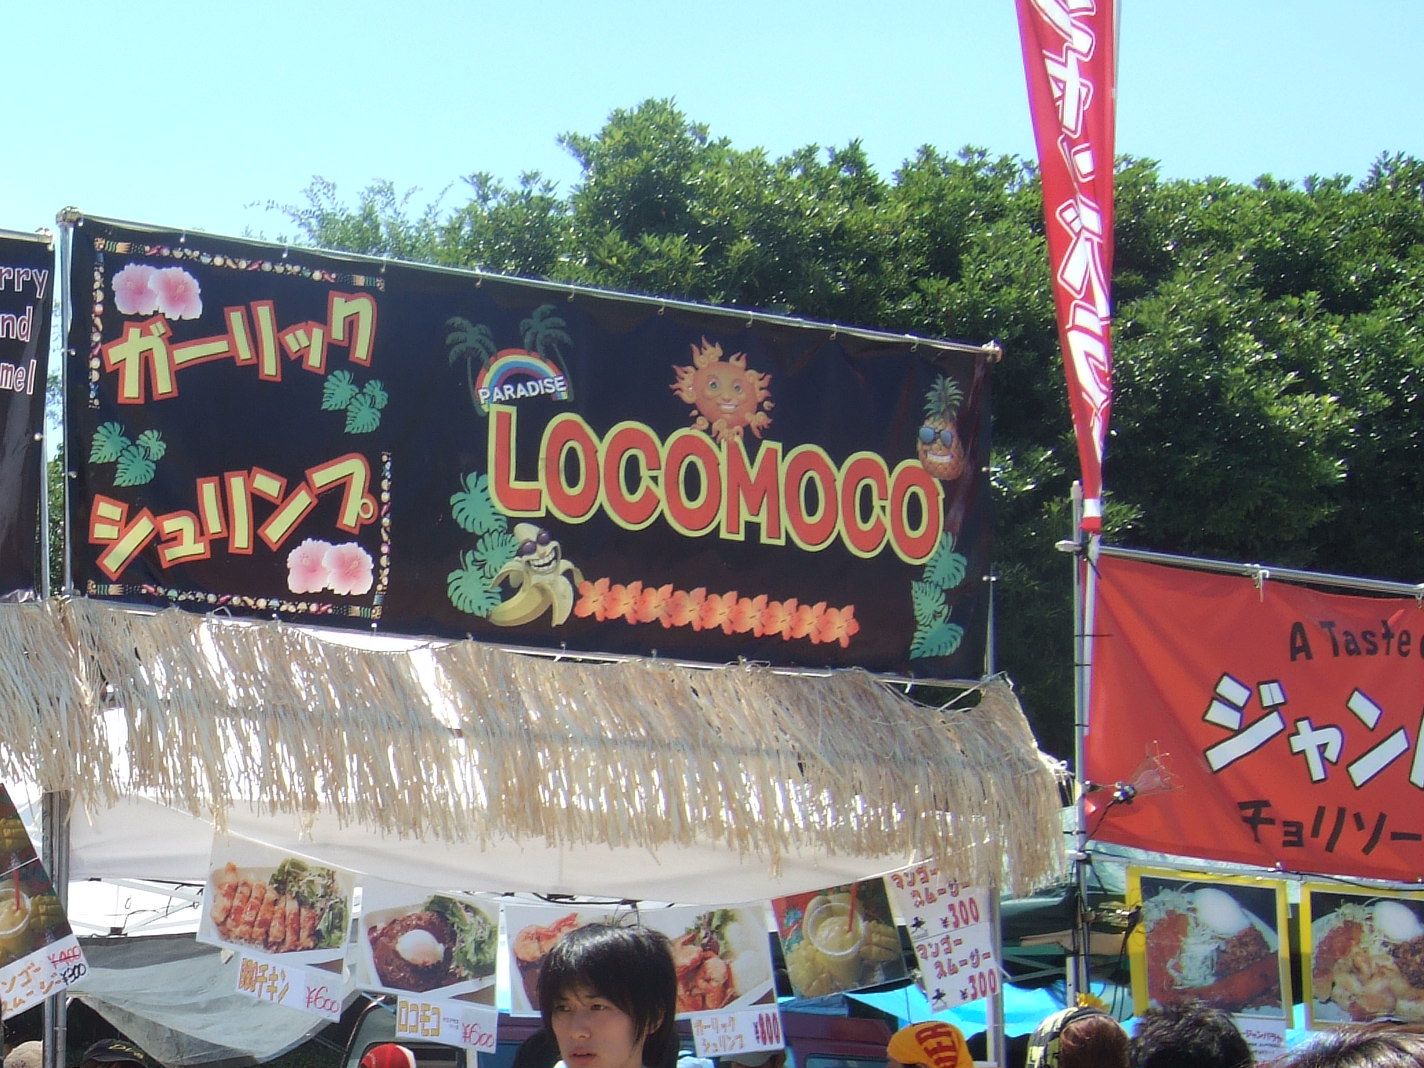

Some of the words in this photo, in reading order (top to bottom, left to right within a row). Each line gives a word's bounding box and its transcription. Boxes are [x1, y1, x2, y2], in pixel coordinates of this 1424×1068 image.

[102, 290, 378, 404] ガーリック
[478, 375, 568, 404] PARADISE
[487, 402, 945, 566] LOCOMOCO
[88, 452, 379, 582] シュリンプ
[1289, 621, 1313, 662] A
[1318, 618, 1411, 658] Taste
[1202, 672, 1424, 790] ジャン
[1237, 800, 1422, 857] チョリソー
[939, 897, 980, 929] ¥300
[959, 968, 998, 1000] ¥300
[398, 1000, 441, 1037] ロコモコ
